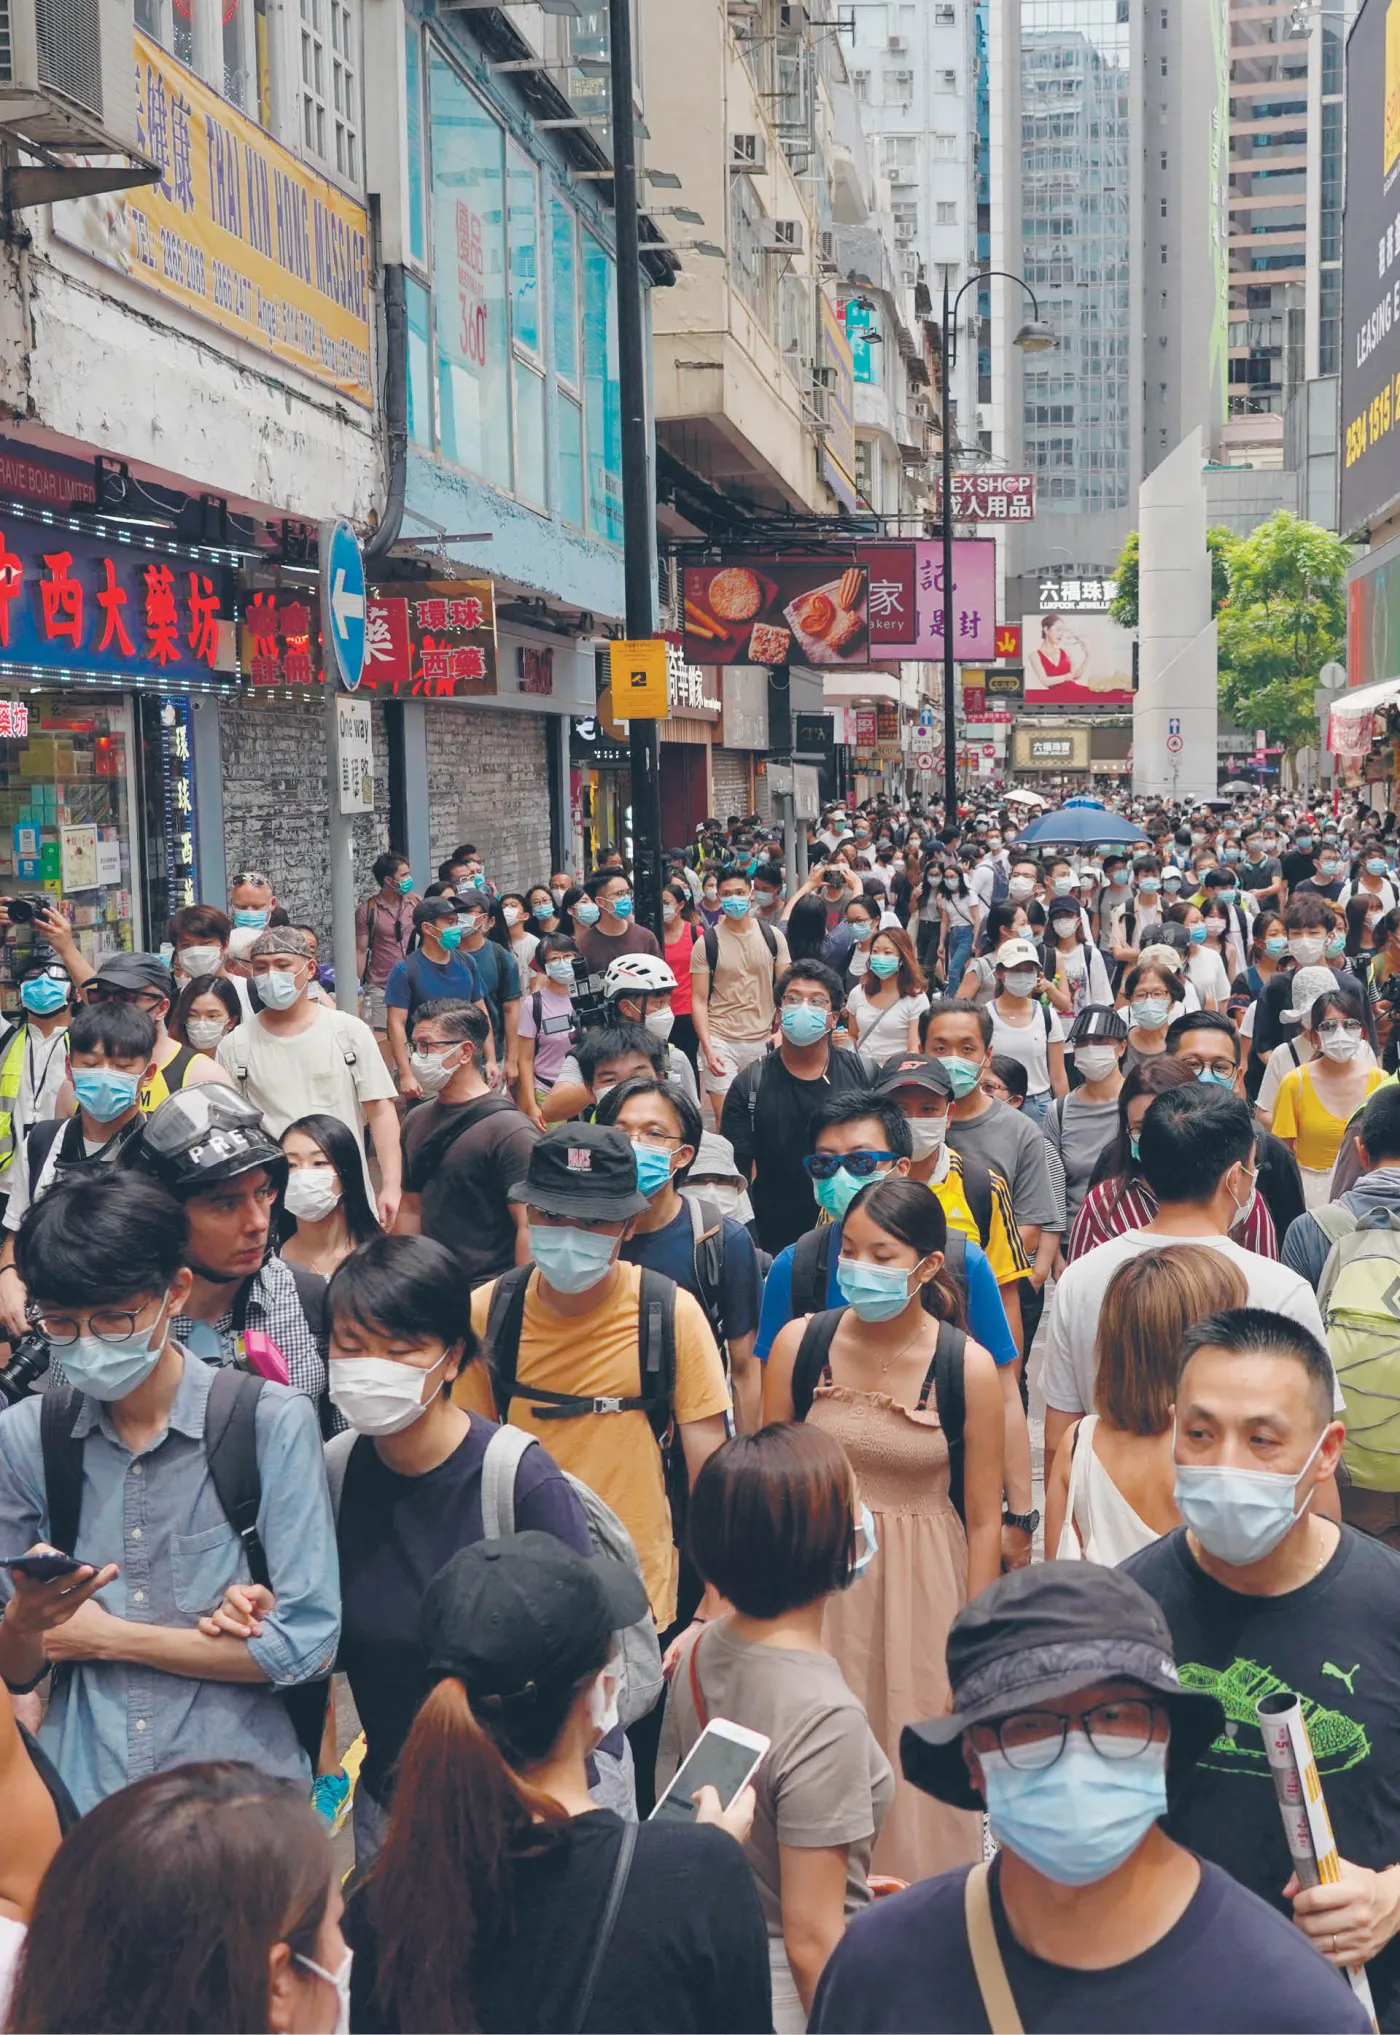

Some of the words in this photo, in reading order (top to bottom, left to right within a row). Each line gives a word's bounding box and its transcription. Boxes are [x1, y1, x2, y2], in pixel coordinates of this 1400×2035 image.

[205, 112, 243, 240] THAI
[273, 167, 312, 285] HONG
[313, 196, 368, 324] MASSAGE
[1356, 291, 1393, 369] LEASING
[1345, 409, 1367, 469] 2534
[1368, 383, 1391, 446] 1515
[28, 466, 57, 498] BOAR
[59, 476, 96, 503] LIMITED
[976, 476, 1031, 494] SHOP
[919, 559, 957, 592] 記
[869, 578, 905, 615] 家
[416, 597, 482, 632] 環球
[916, 609, 981, 639] 是封
[996, 631, 1017, 653] 山
[420, 646, 486, 680] 西藥
[0, 702, 28, 737] 藥坊
[340, 710, 353, 738] One
[353, 718, 369, 744] way
